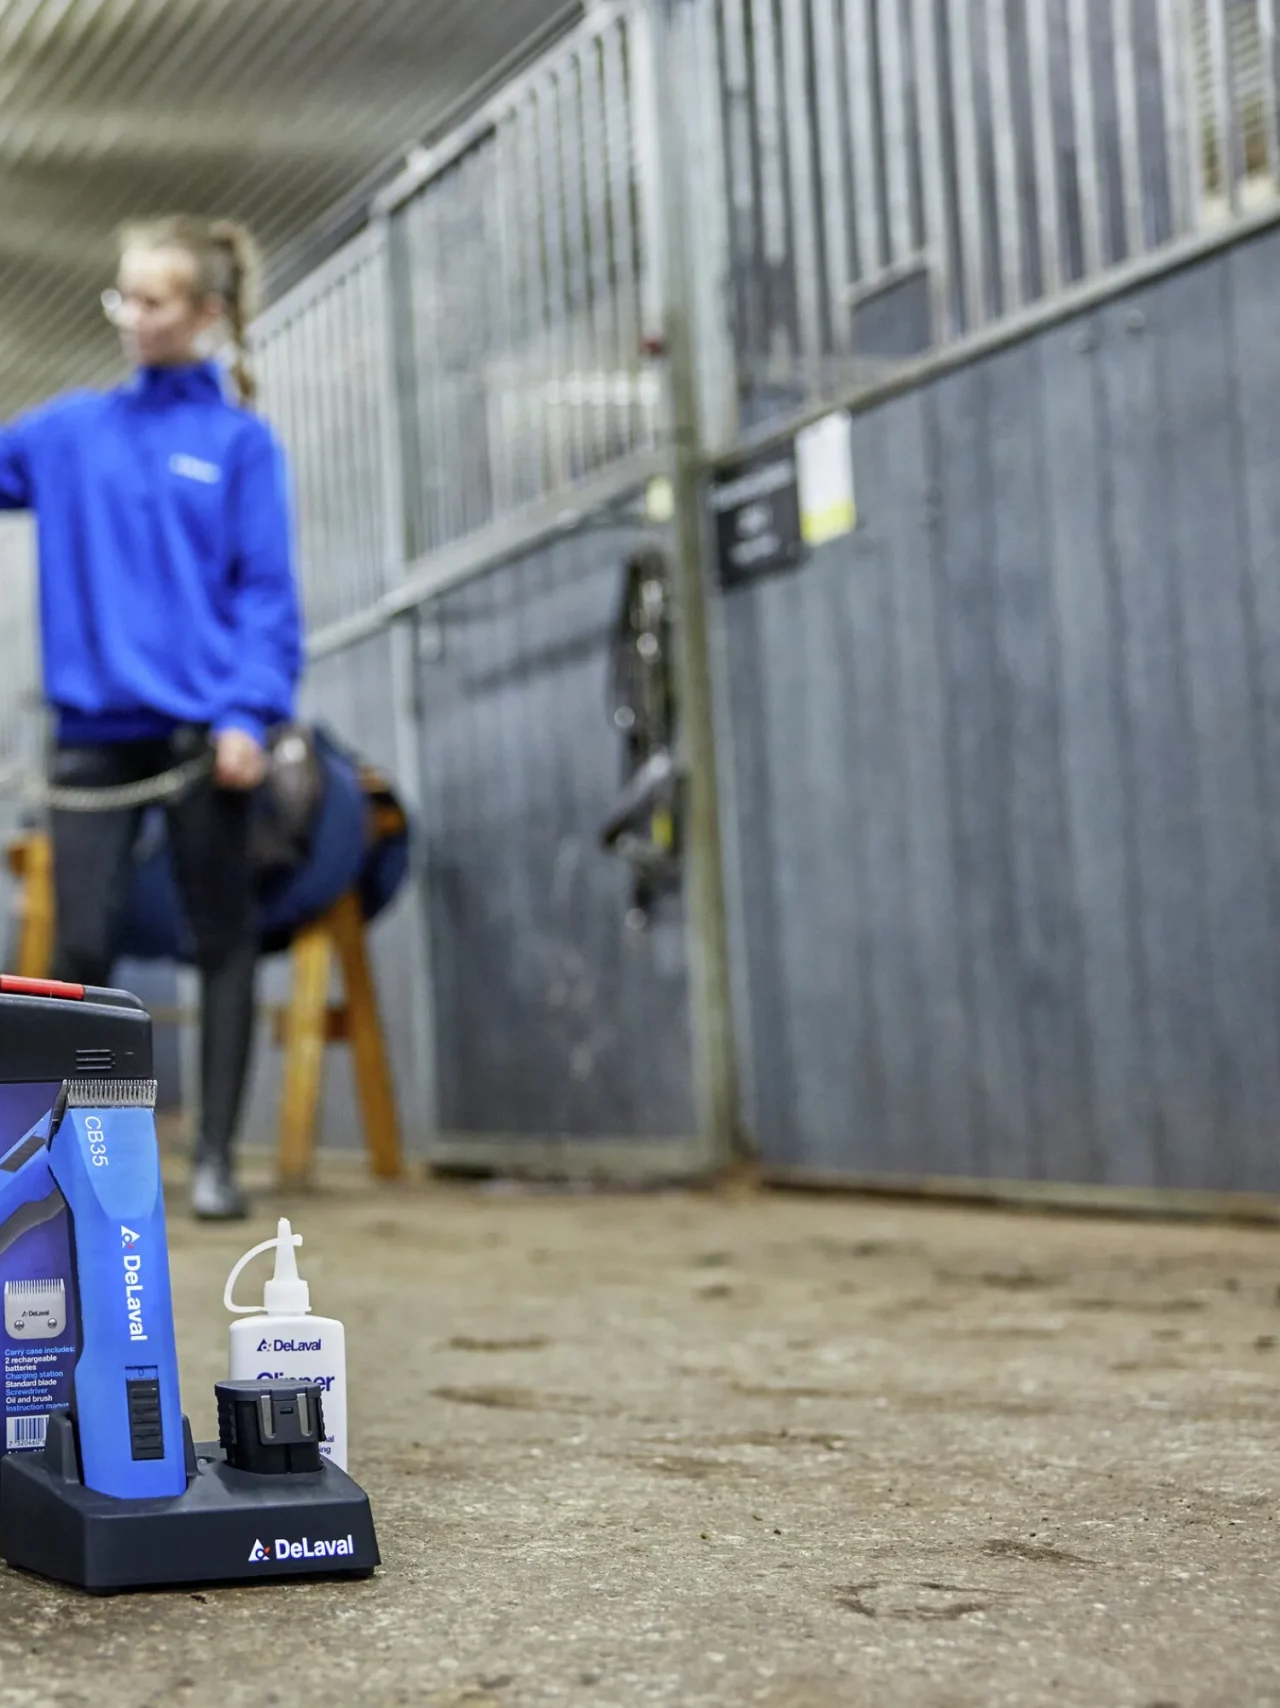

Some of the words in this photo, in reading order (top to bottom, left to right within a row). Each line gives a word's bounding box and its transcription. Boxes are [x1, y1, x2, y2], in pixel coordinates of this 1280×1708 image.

[84, 1116, 109, 1168] CB35
[123, 1255, 148, 1341] DeLaval
[273, 1338, 321, 1352] DeLaval
[4, 1348, 25, 1356] Carry
[11, 1354, 58, 1364] rechargeable
[5, 1363, 37, 1372] batteries
[5, 1372, 38, 1380] Charging
[39, 1370, 64, 1378] station
[5, 1380, 37, 1388] Standard
[37, 1378, 58, 1386] blade
[5, 1388, 48, 1396] Screwdriver
[5, 1396, 16, 1404] Oil
[17, 1395, 31, 1404] and
[32, 1394, 53, 1402] brush
[5, 1403, 45, 1412] Instruction
[274, 1534, 354, 1560] DeLaval
